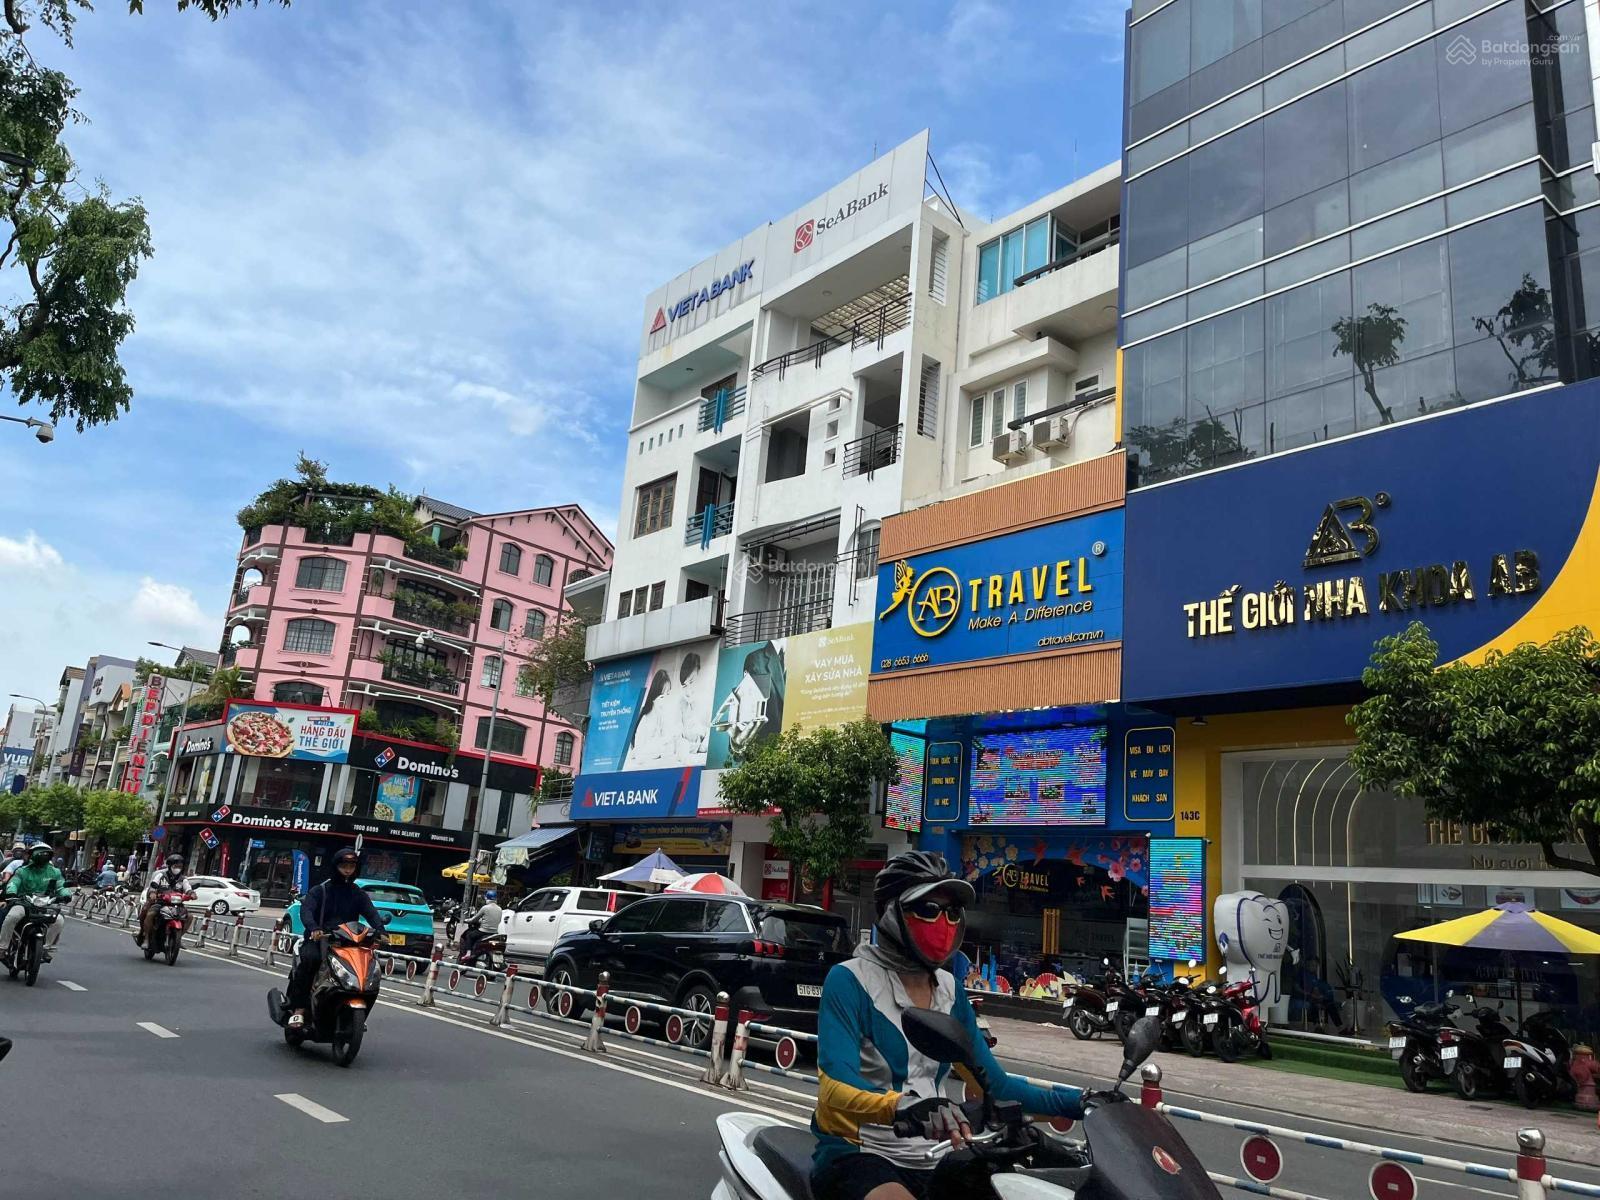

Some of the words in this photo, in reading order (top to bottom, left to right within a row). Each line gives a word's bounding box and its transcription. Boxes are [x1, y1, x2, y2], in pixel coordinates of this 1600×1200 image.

[816, 183, 889, 235] SeABank
[969, 557, 1094, 612] TRAVEL
[1183, 584, 1243, 638] THẾ
[1304, 576, 1368, 622] NHA
[1379, 560, 1475, 613] KHOA
[1487, 550, 1541, 597] AB
[968, 615, 1001, 631] Make
[1008, 613, 1018, 625] A
[1024, 600, 1093, 622] Difference
[815, 657, 834, 669] VAY
[834, 654, 855, 667] MUA
[300, 724, 326, 737] HÀNG
[186, 738, 213, 753] Domino's
[397, 756, 459, 779] Domino's
[626, 788, 659, 805] BANK
[232, 813, 291, 828] Domino's
[293, 818, 330, 832] Pizza
[1180, 810, 1201, 821] 143C
